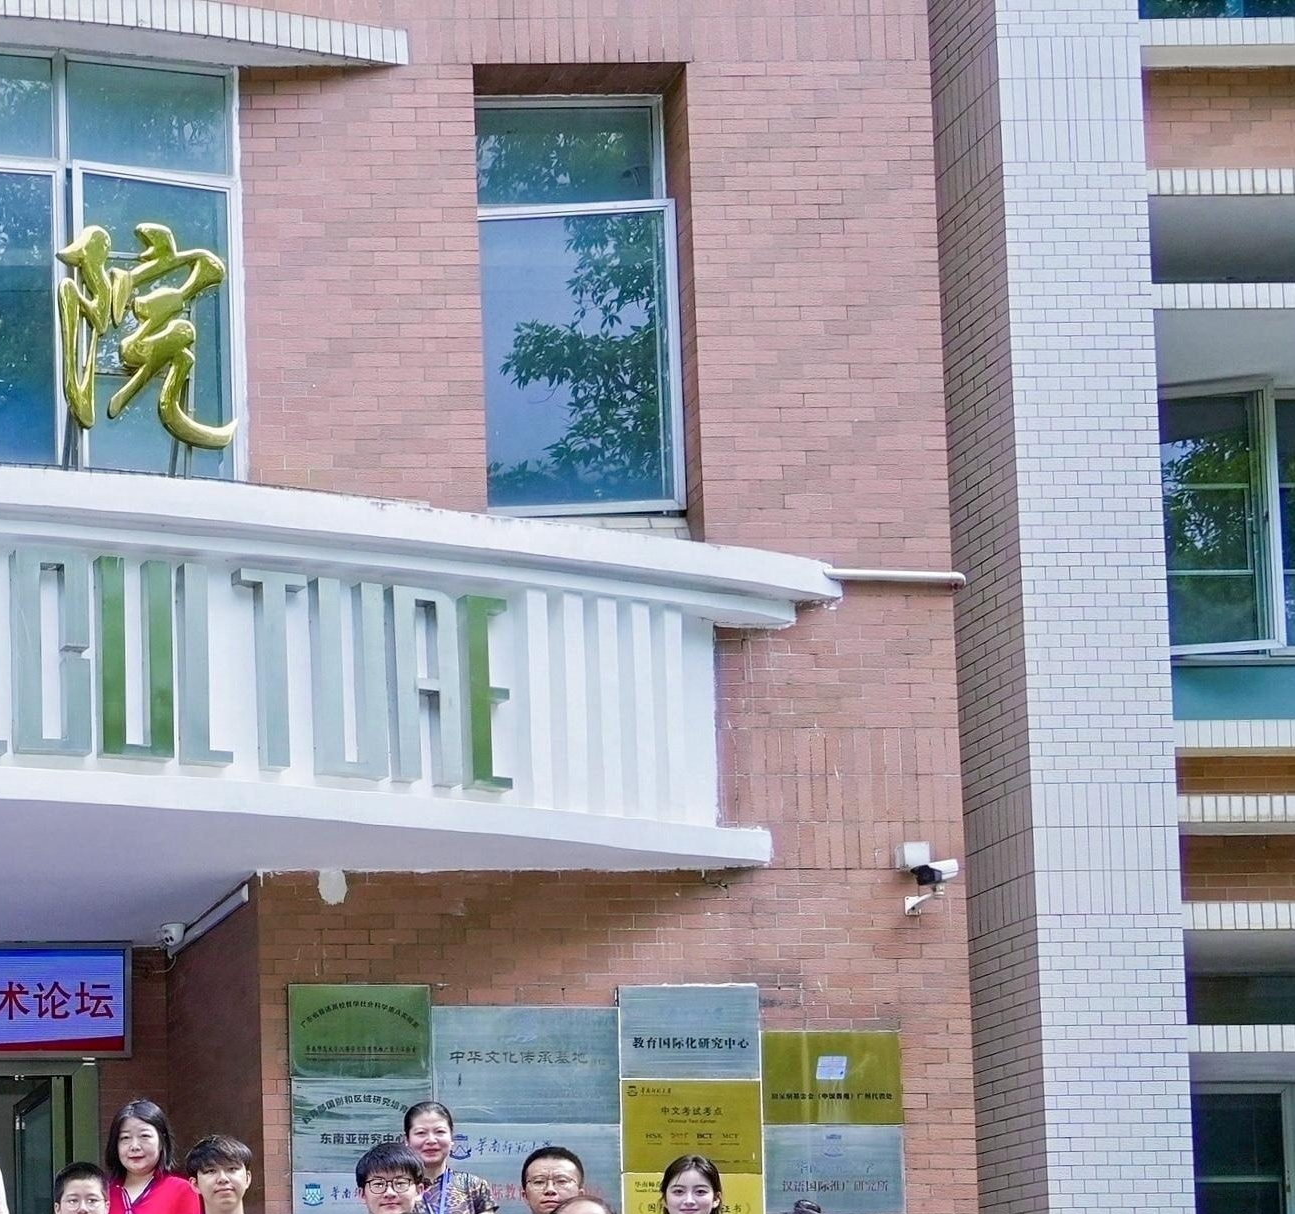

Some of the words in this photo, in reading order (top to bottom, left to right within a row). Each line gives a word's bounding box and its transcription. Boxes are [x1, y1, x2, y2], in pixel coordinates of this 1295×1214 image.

[633, 1036, 749, 1050] 教育国际化研究中心
[660, 1106, 723, 1117] 中文考试考点
